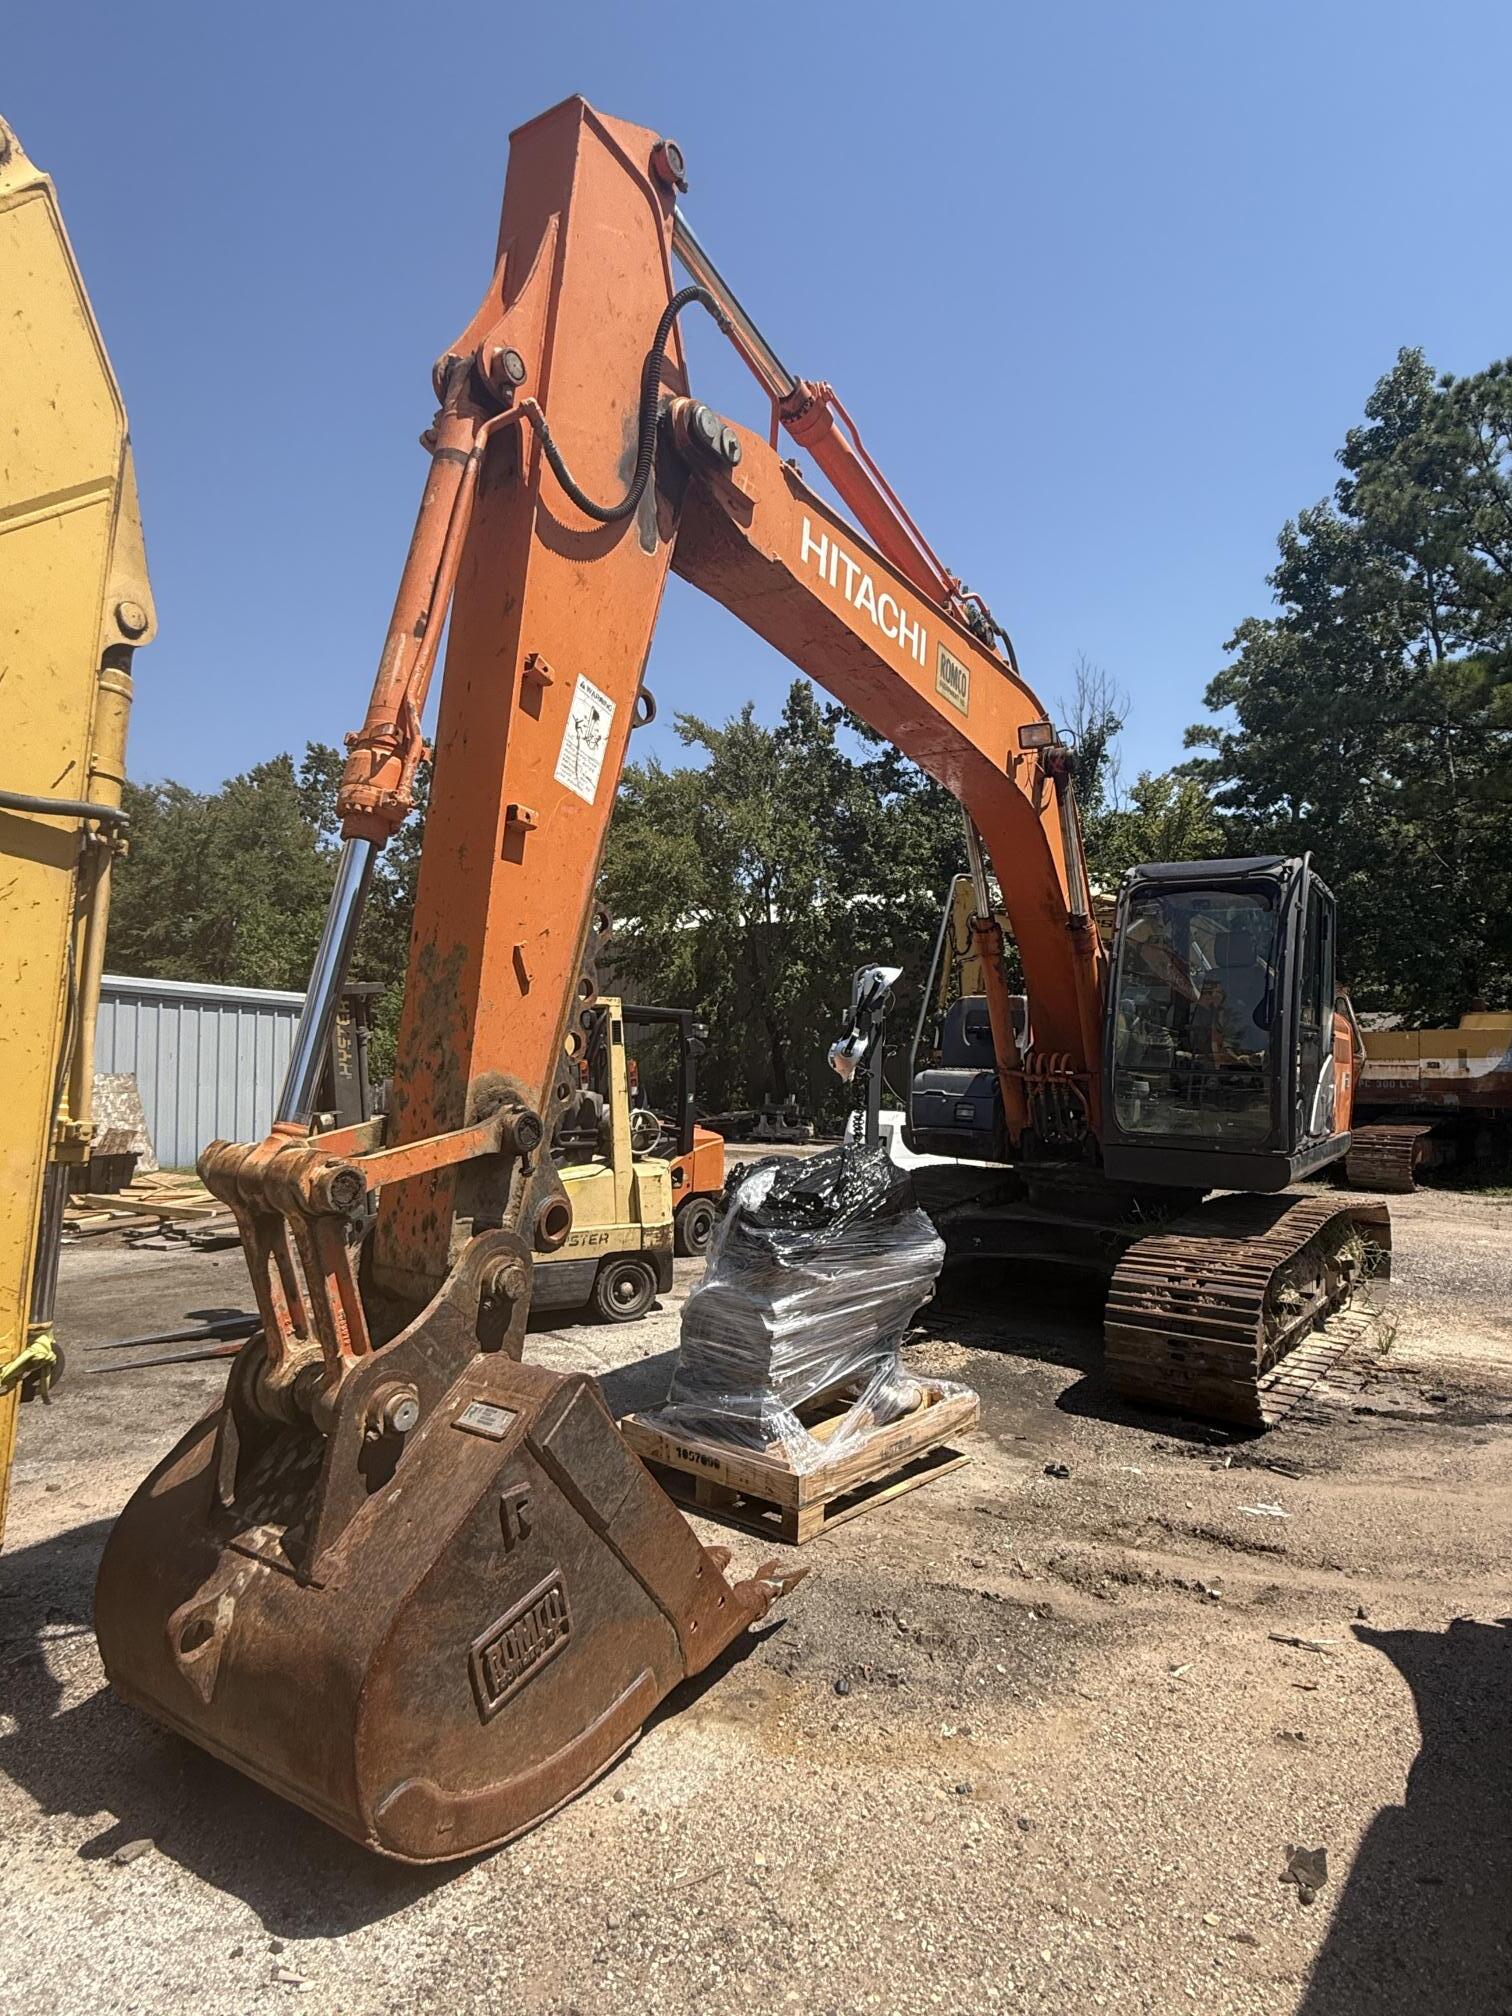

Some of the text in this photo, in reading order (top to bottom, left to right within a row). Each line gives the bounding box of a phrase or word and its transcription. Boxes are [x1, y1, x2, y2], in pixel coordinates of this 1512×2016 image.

[801, 516, 927, 667] HITACHI
[940, 653, 967, 698] ROMCO
[563, 1232, 609, 1247] STER
[484, 1588, 563, 1694] ROMCO
